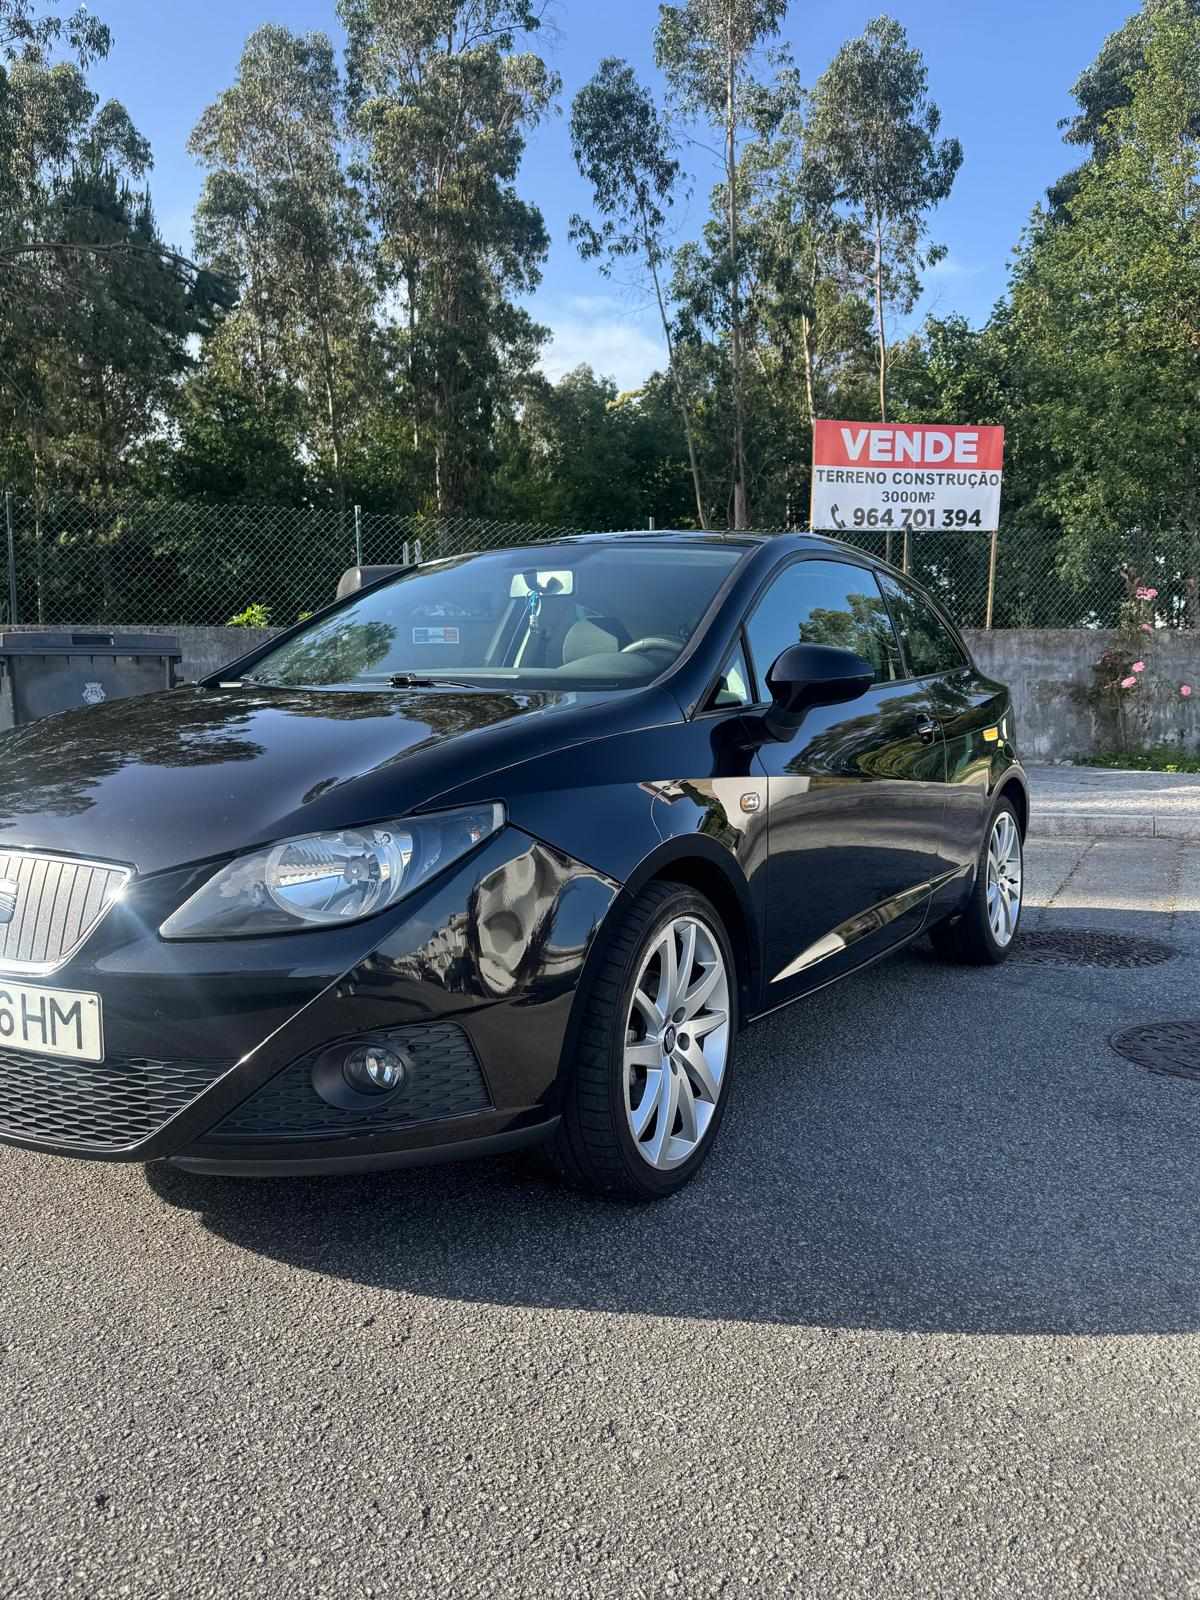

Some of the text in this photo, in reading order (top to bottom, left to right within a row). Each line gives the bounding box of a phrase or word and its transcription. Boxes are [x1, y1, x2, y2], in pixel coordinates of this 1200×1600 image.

[841, 429, 978, 463] VENDE
[816, 469, 999, 488] TERRENO CONSTRUÇÃO
[853, 508, 982, 527] 964 701 394
